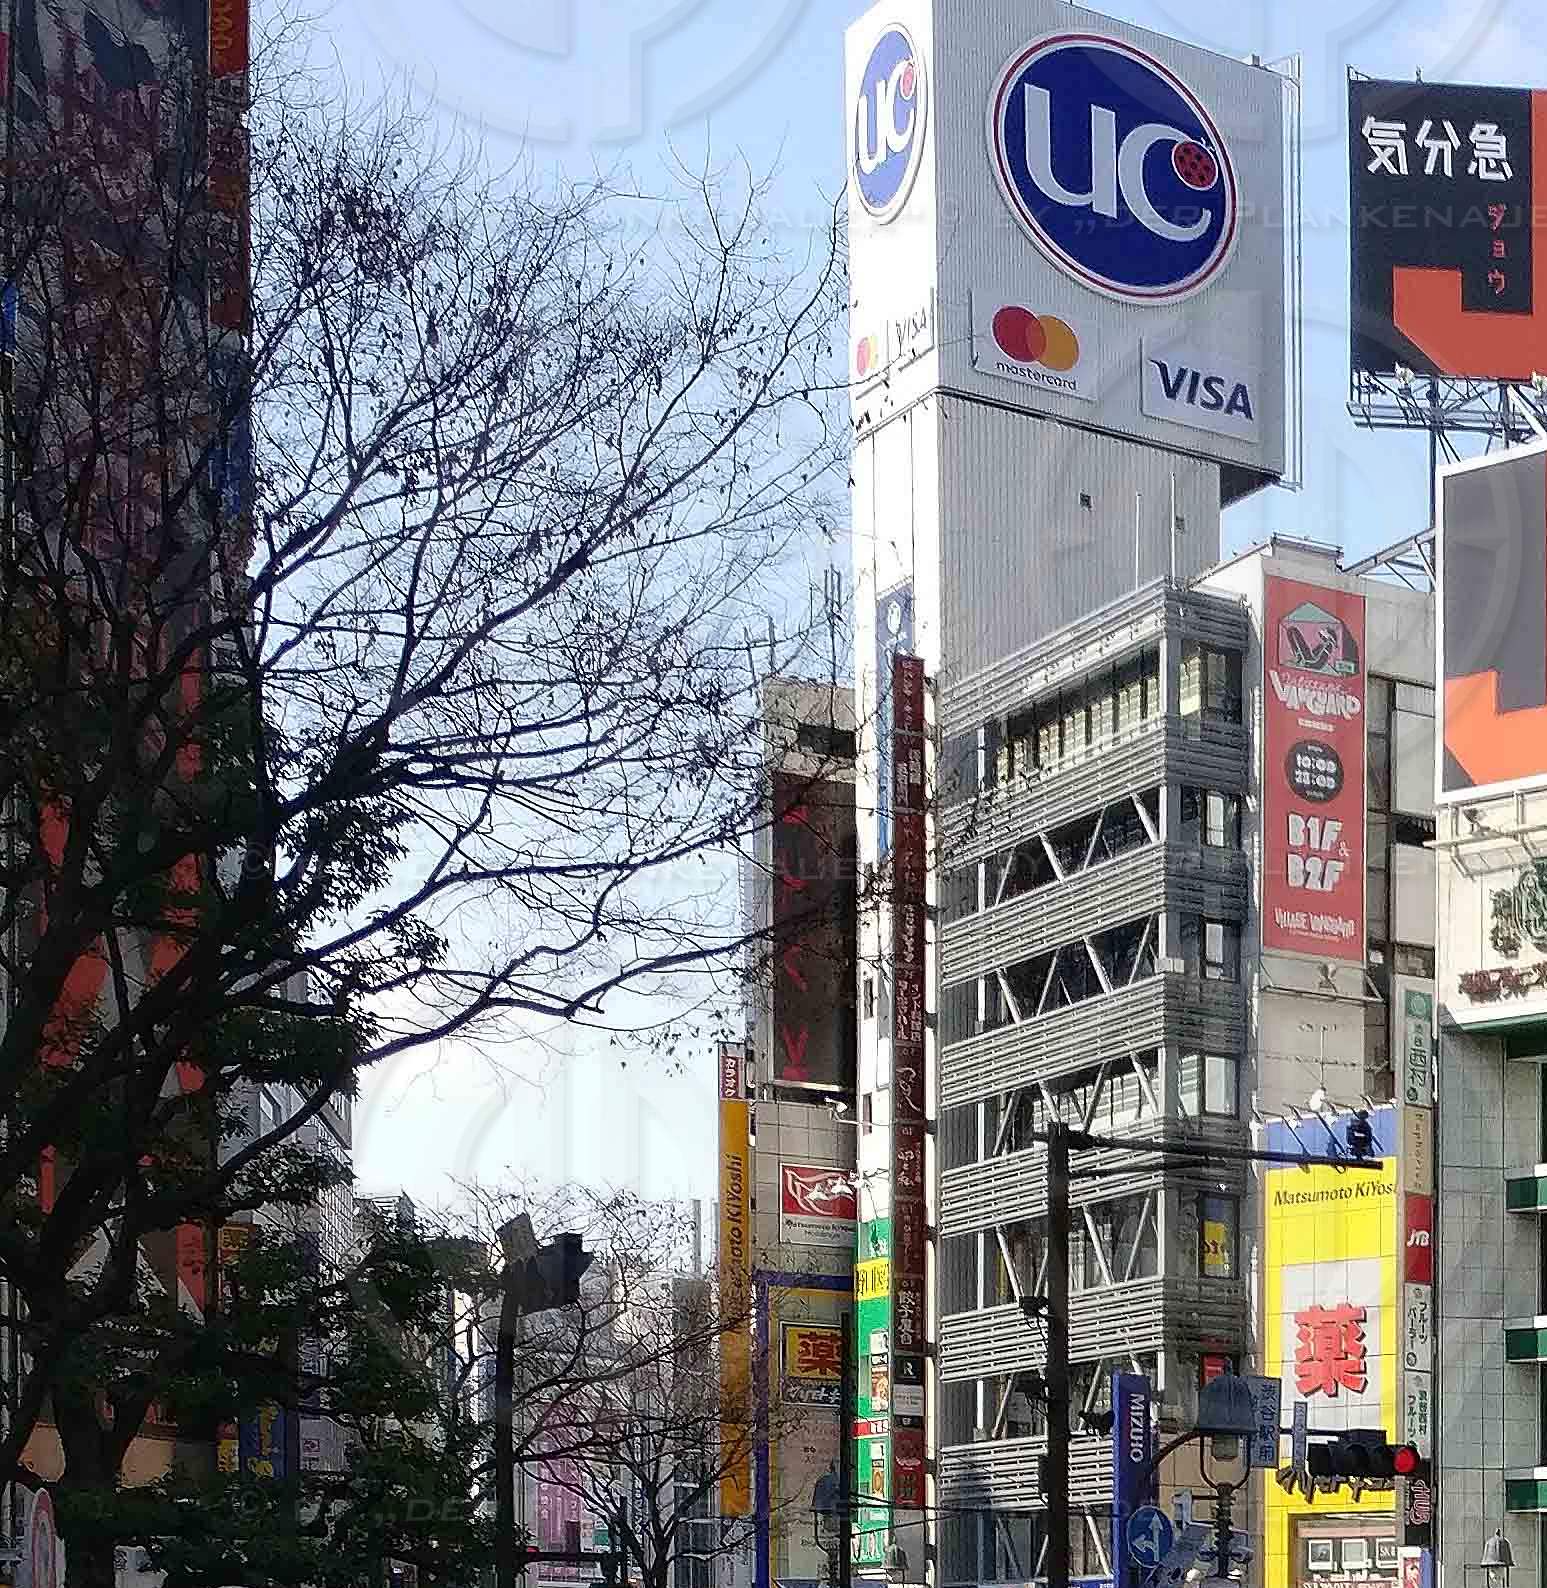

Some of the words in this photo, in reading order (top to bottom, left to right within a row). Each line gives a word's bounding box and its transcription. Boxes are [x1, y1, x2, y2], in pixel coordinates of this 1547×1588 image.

[1361, 116, 1513, 182] 気分急
[1150, 358, 1255, 421] VISA
[1273, 1186, 1353, 1207] Matsumoto
[1407, 1229, 1430, 1247] JTB
[1294, 1305, 1368, 1396] 薬
